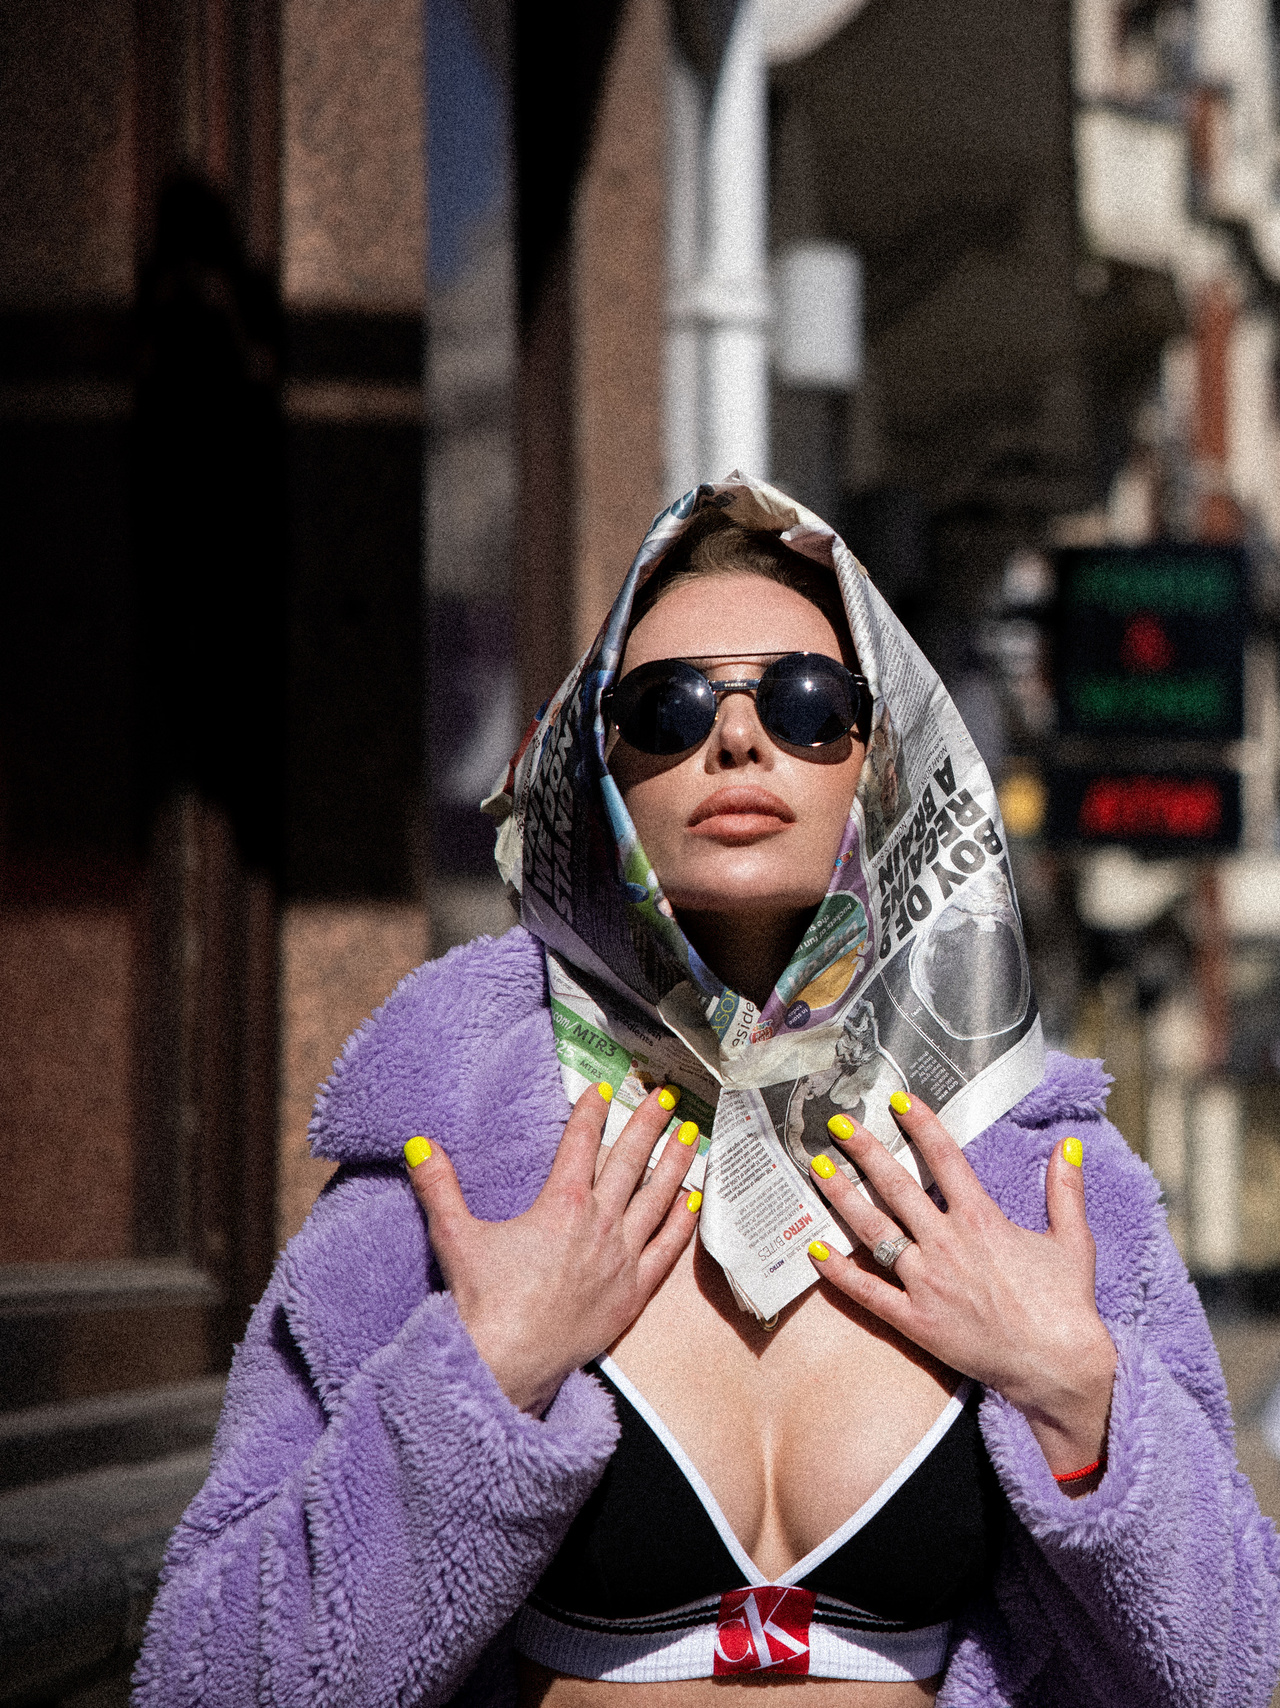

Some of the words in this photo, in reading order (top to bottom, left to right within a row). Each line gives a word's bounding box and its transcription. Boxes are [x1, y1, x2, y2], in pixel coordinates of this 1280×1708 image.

[930, 744, 947, 769] NOAH
[933, 755, 956, 797] A
[879, 783, 938, 897] BRAIN
[893, 820, 907, 841] NOW
[553, 775, 573, 924] STAND
[881, 788, 987, 932] REGAINS
[931, 818, 1003, 899] BOY
[816, 913, 830, 927] the
[825, 902, 852, 929] buckets
[895, 884, 932, 942] OF
[803, 935, 819, 948] fun
[788, 1012, 802, 1025] store
[579, 1060, 602, 1078] MTR3
[782, 1212, 812, 1240] METRO
[756, 1235, 784, 1261] BITES
[800, 1237, 811, 1247] March
[769, 1259, 784, 1272] METRO
